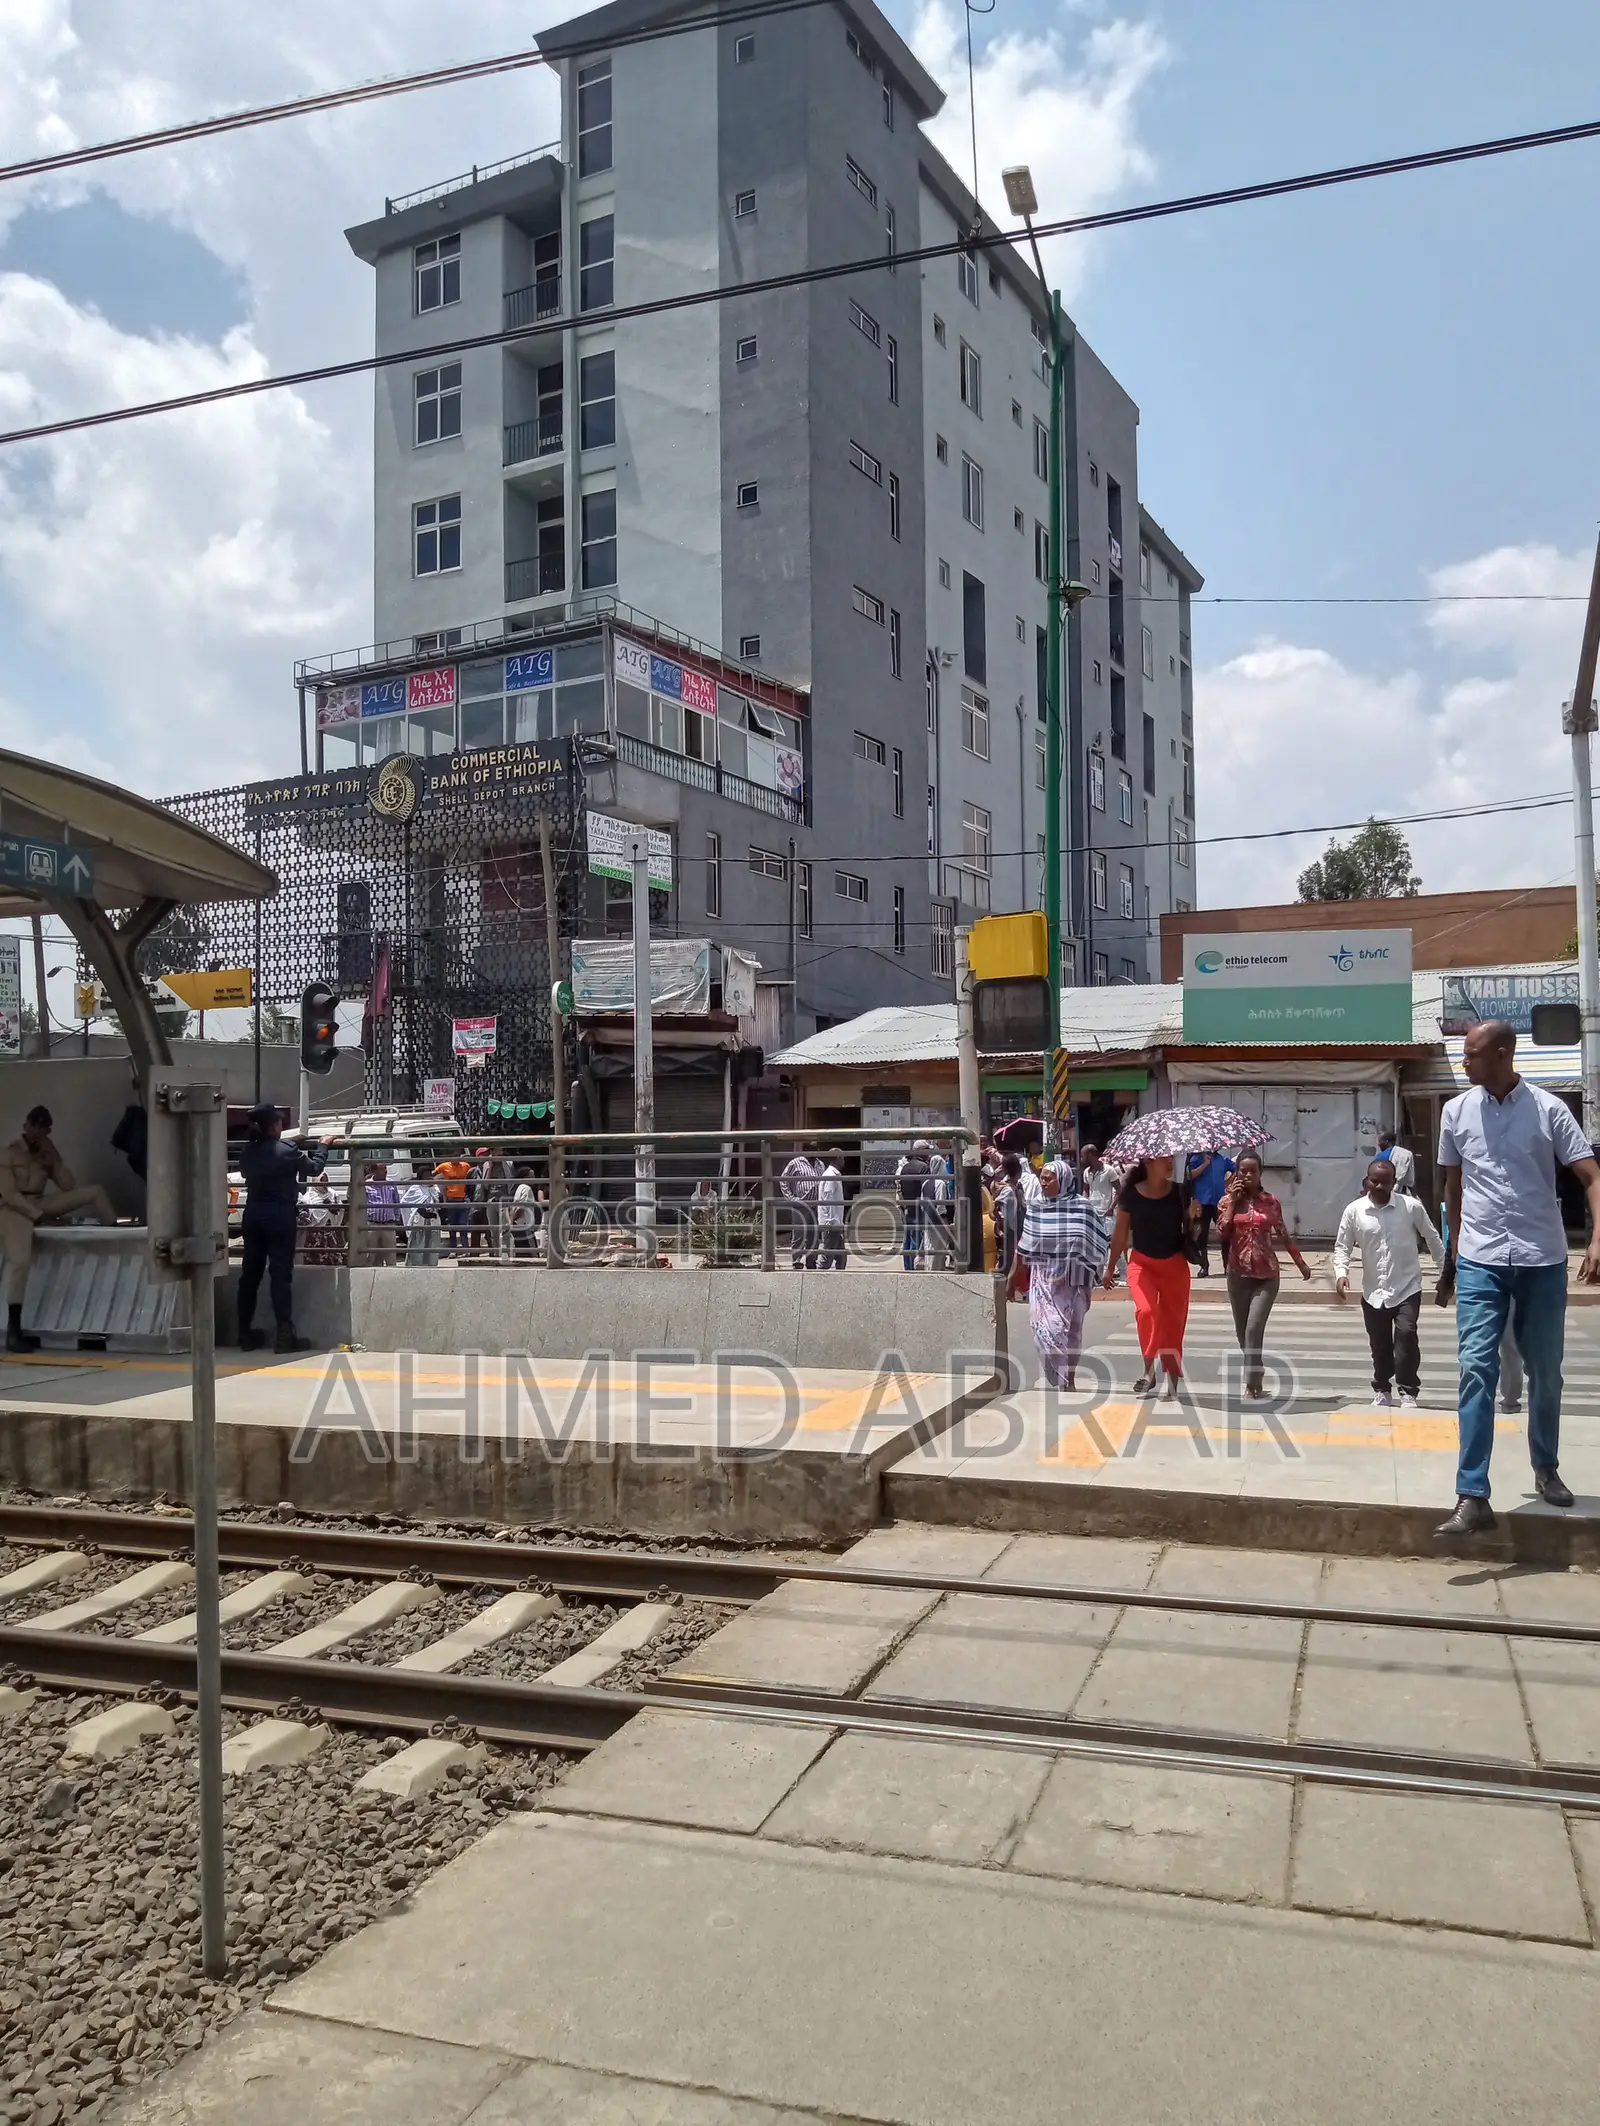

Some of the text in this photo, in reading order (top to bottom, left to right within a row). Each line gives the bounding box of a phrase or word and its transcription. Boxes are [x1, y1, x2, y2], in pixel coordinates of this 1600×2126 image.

[506, 652, 551, 678] ATG
[617, 646, 648, 674] ATG
[652, 660, 681, 688] ATG
[363, 680, 404, 705] ATG
[451, 746, 540, 770] COMMERCIAL
[431, 759, 562, 790] BANK OF ETHIOPIA
[304, 783, 331, 798] ንግድ
[336, 780, 360, 794] ባንክ
[439, 781, 555, 806] SHELL DEPOT BRANCH
[590, 826, 604, 837] YAYA
[606, 831, 623, 841] ADVER
[604, 819, 631, 834] ማስታወቂ
[1225, 954, 1288, 966] ethio telecom
[1514, 976, 1578, 998] ROSES
[1480, 1001, 1518, 1016] FLOWER
[430, 1083, 448, 1094] ATG
